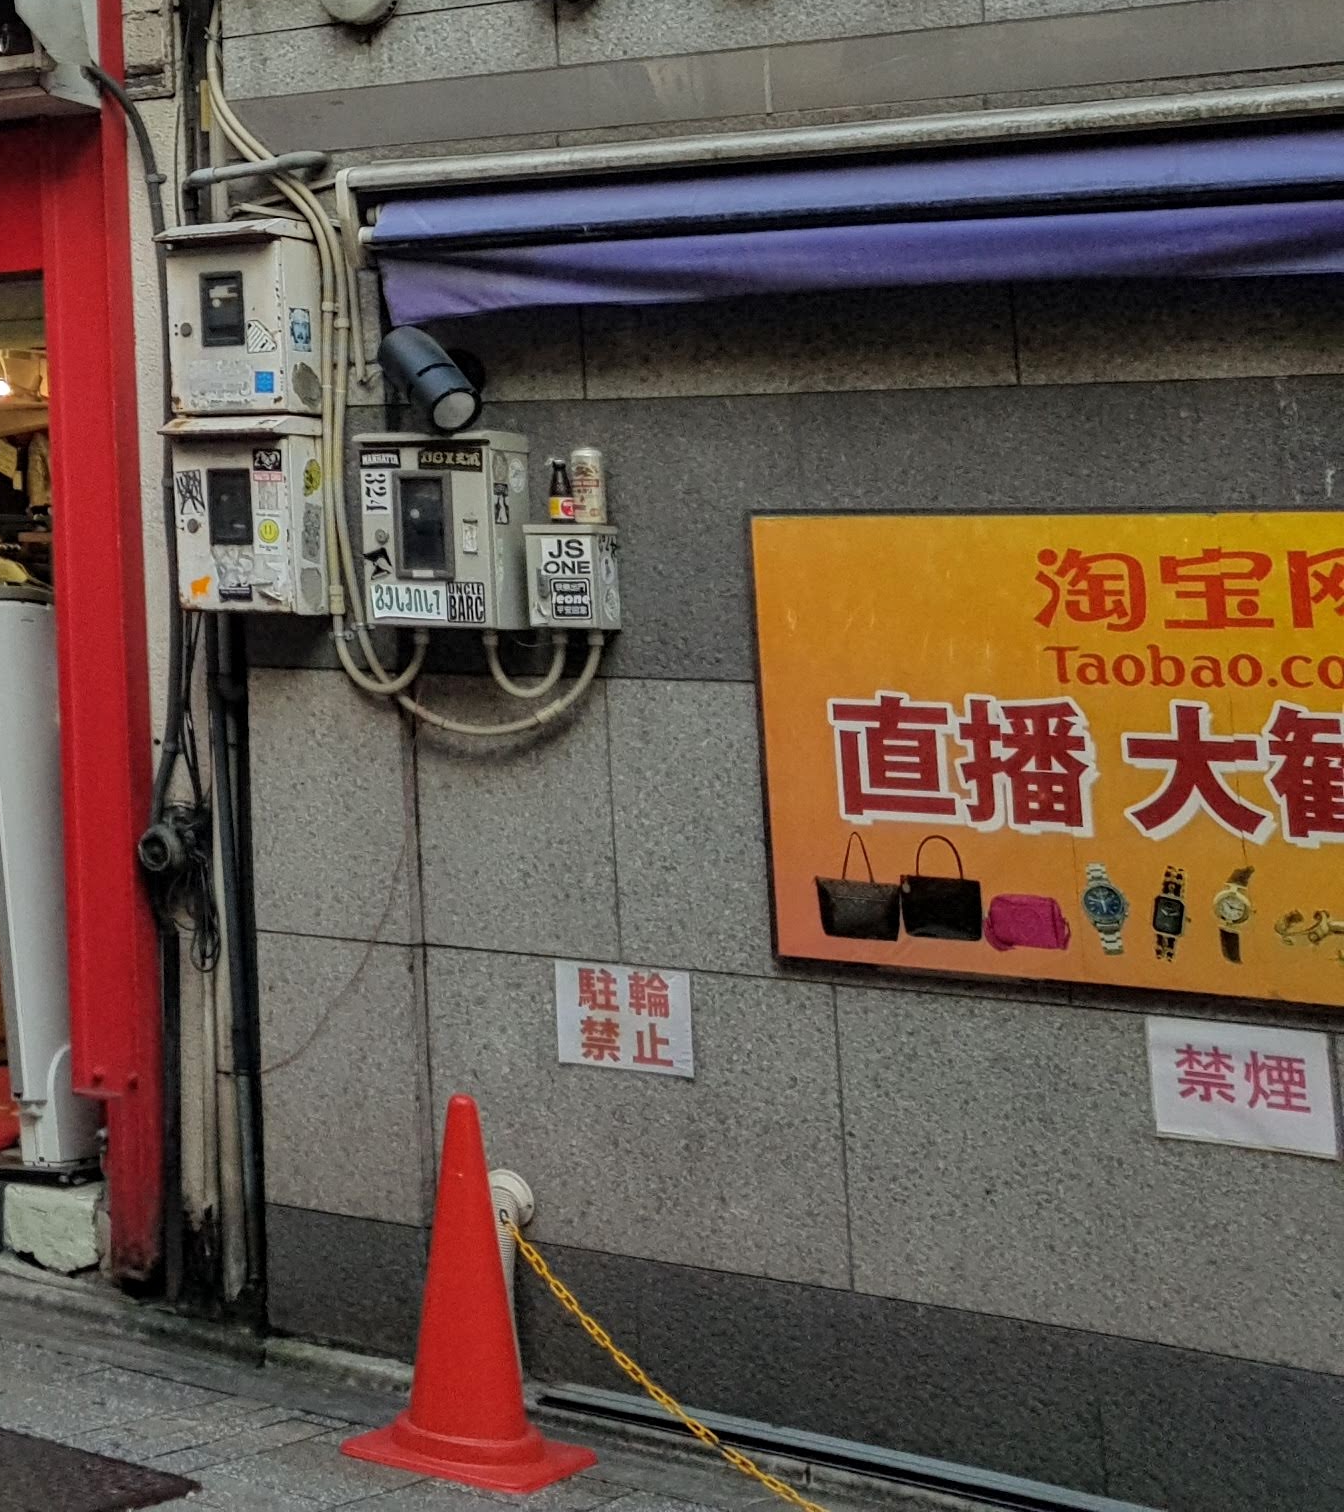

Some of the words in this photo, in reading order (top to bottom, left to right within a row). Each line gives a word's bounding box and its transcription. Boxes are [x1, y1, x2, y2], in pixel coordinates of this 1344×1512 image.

[543, 560, 592, 575] ONE
[548, 538, 585, 559] JS
[828, 691, 1098, 835] 直播
[577, 967, 670, 1020] 駐輪
[580, 1016, 674, 1068] 禁止
[1174, 1041, 1311, 1116] 禁煙
